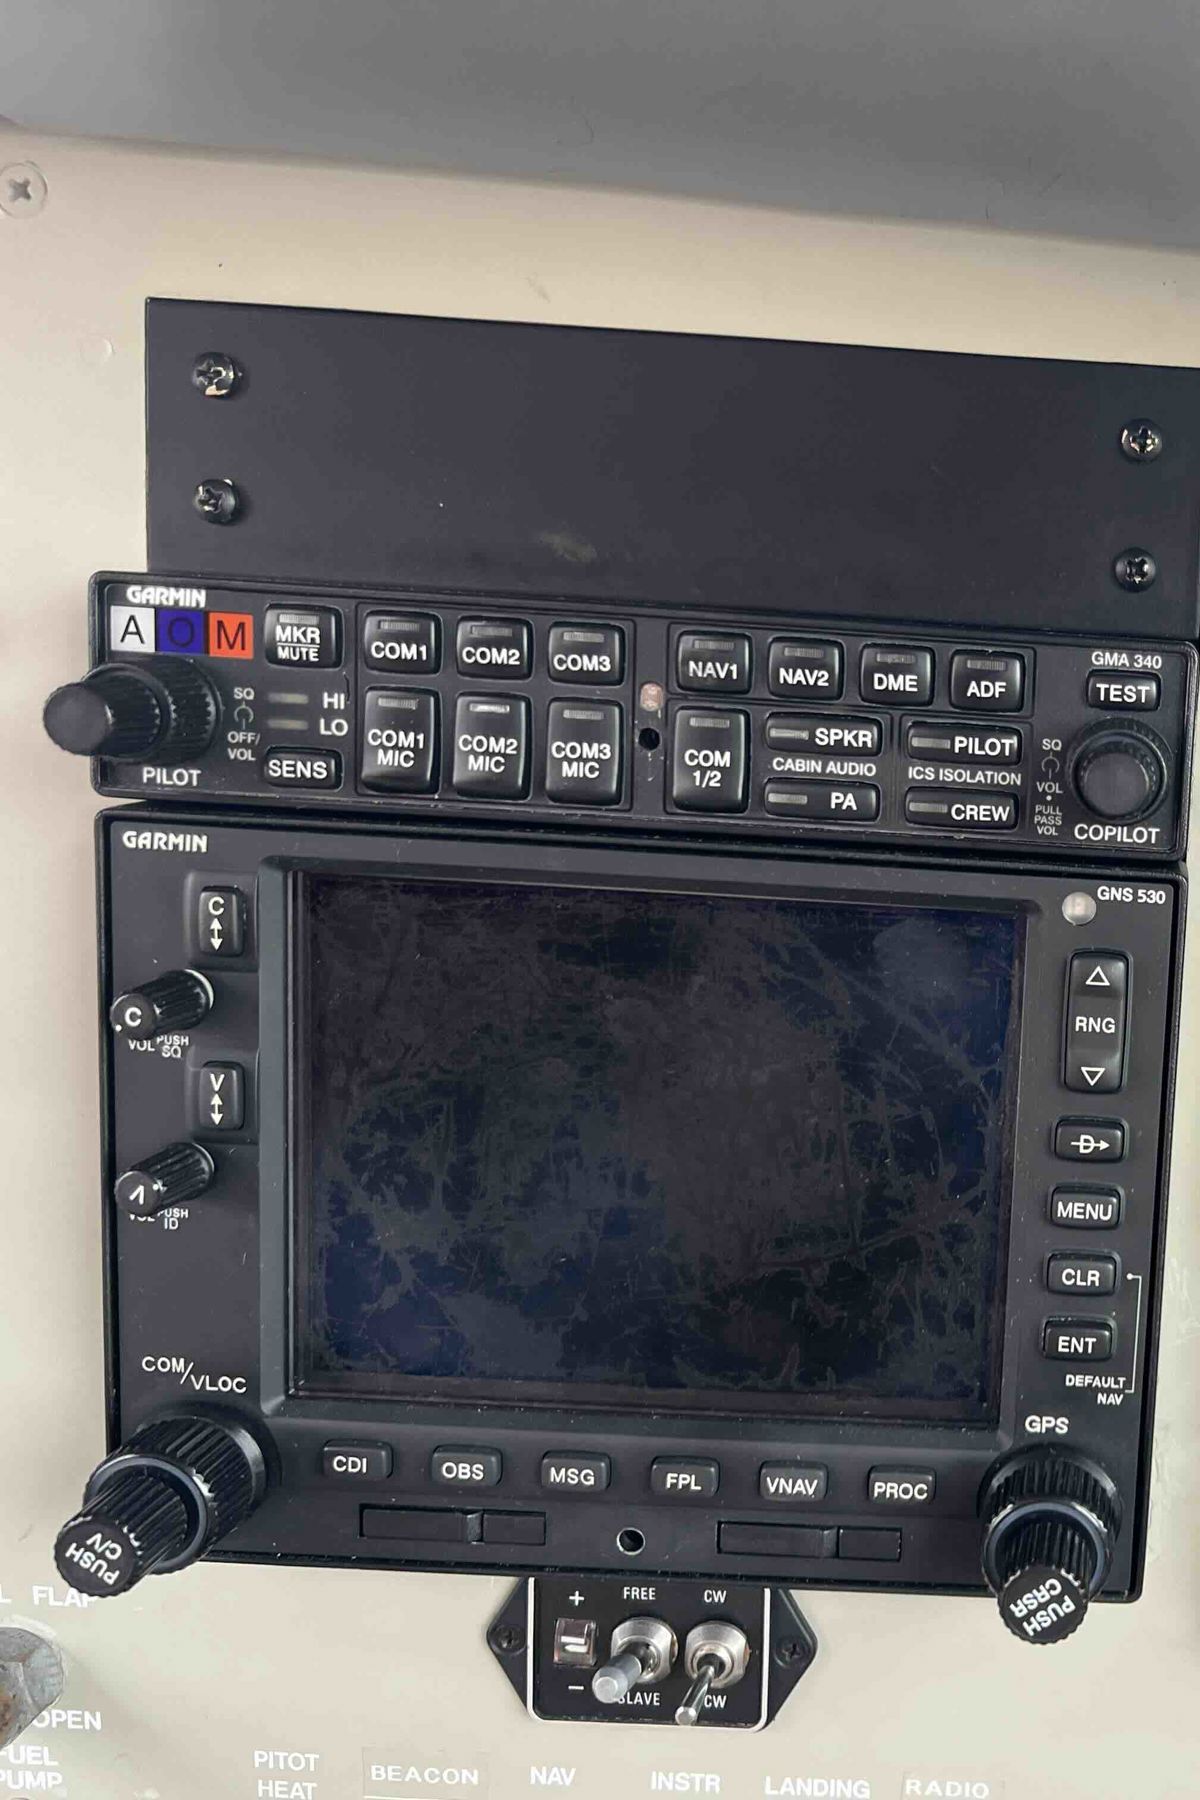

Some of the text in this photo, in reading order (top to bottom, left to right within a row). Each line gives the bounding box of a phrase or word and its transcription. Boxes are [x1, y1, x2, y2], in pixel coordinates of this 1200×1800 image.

[127, 586, 206, 608] GARMIN
[276, 626, 320, 645] MKR
[278, 647, 318, 662] MUTE
[371, 642, 428, 660] COM1
[462, 646, 520, 665] COM2
[554, 653, 610, 672] COM3
[1092, 652, 1162, 669] GMA 340
[689, 661, 738, 680] NAV1
[779, 669, 829, 687] NAV2
[873, 675, 918, 693] DME
[967, 681, 1006, 698] ADF
[323, 693, 345, 710] HI
[1097, 685, 1150, 703] TEST
[320, 720, 348, 736] LO
[368, 729, 424, 749] COM1
[459, 735, 517, 755] COM2
[815, 728, 872, 748] SPKR
[954, 737, 1015, 757] PILOT
[228, 748, 255, 761] VOL
[377, 749, 414, 768] MIC
[552, 742, 611, 760] COM3
[685, 750, 731, 769] COM
[269, 761, 327, 779] SENS
[468, 754, 505, 773] MIC
[562, 759, 600, 779] MIC
[773, 758, 876, 776] CABIN AUDIO
[143, 767, 200, 787] PILOT
[908, 767, 1021, 786] ICS ISOLATION
[1037, 782, 1063, 795] VOL
[830, 793, 857, 810] PA
[951, 804, 1010, 822] CREW
[123, 831, 208, 852] GARMIN
[1075, 825, 1160, 844] COPILOT
[1097, 887, 1166, 904] GNS 530
[1076, 1017, 1115, 1033] RNG
[1057, 1202, 1112, 1220] MENU
[1062, 1270, 1099, 1286] CLR
[1058, 1337, 1096, 1354] ENT
[1066, 1375, 1125, 1389] DEFAULT
[1098, 1392, 1123, 1405] NAV
[1025, 1415, 1069, 1434] GPS
[333, 1456, 367, 1473] CDI
[442, 1463, 484, 1480] OBS
[550, 1468, 594, 1485] MSG
[666, 1473, 701, 1491] FPL
[766, 1476, 818, 1495] VNAV
[873, 1481, 928, 1500] PROC
[624, 1587, 655, 1600] FREE
[704, 1590, 726, 1603] CW
[704, 1695, 726, 1709] CW
[34, 1711, 101, 1729] OPEN
[254, 1750, 319, 1771] PITOT
[371, 1765, 478, 1785] BEACON
[531, 1767, 575, 1786] NAV
[651, 1772, 720, 1794] INSTR
[258, 1780, 316, 1800] HEAT
[765, 1777, 870, 1798] LANDING
[906, 1779, 989, 1798] RADIO
